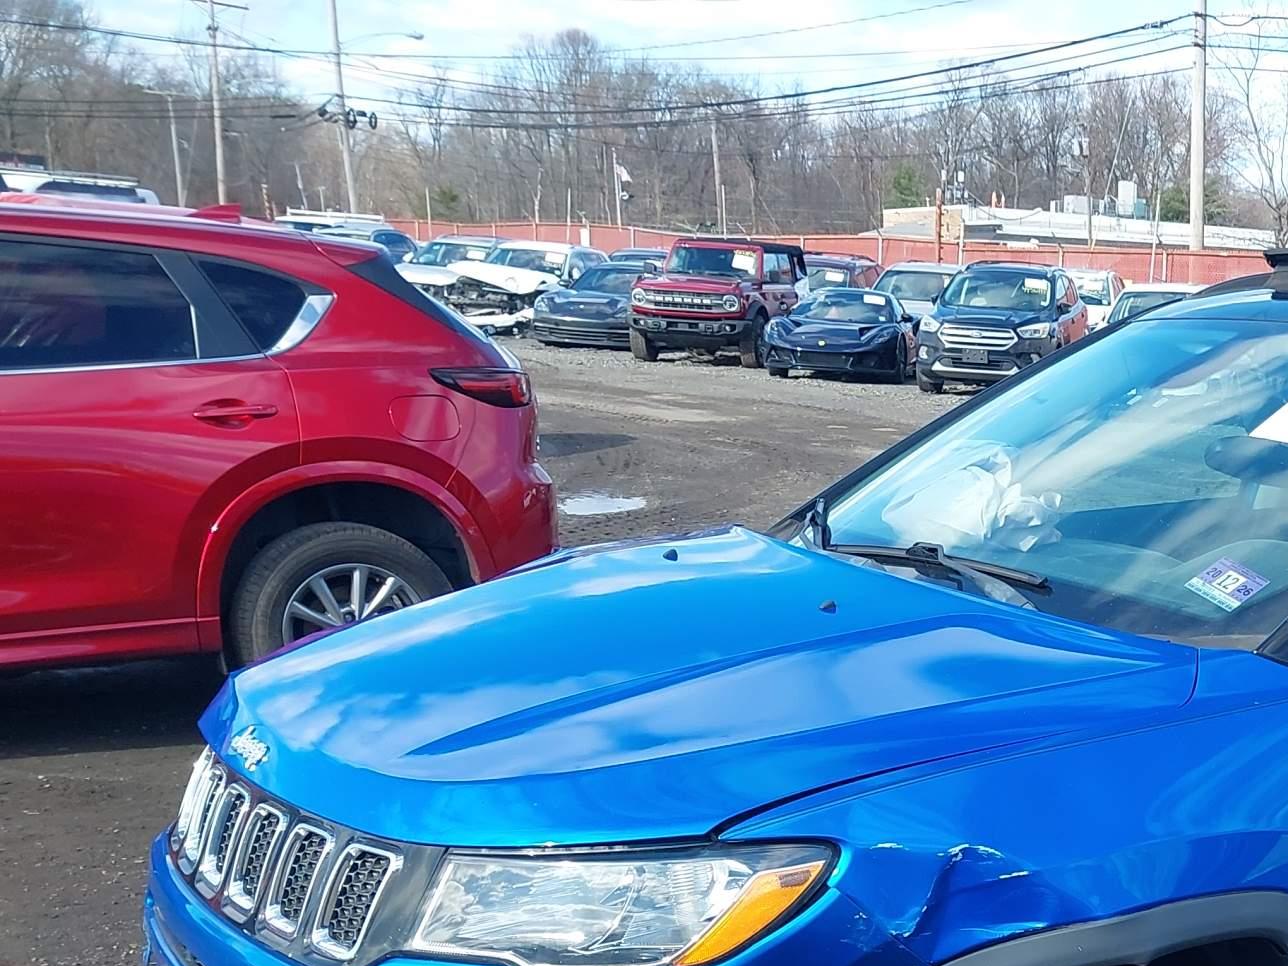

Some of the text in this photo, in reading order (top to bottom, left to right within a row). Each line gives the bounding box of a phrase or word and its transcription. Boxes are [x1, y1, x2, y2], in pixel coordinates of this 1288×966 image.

[1206, 567, 1222, 578] 20
[1217, 574, 1240, 590] 12
[1237, 584, 1254, 597] 26
[231, 726, 269, 772] Jeep
